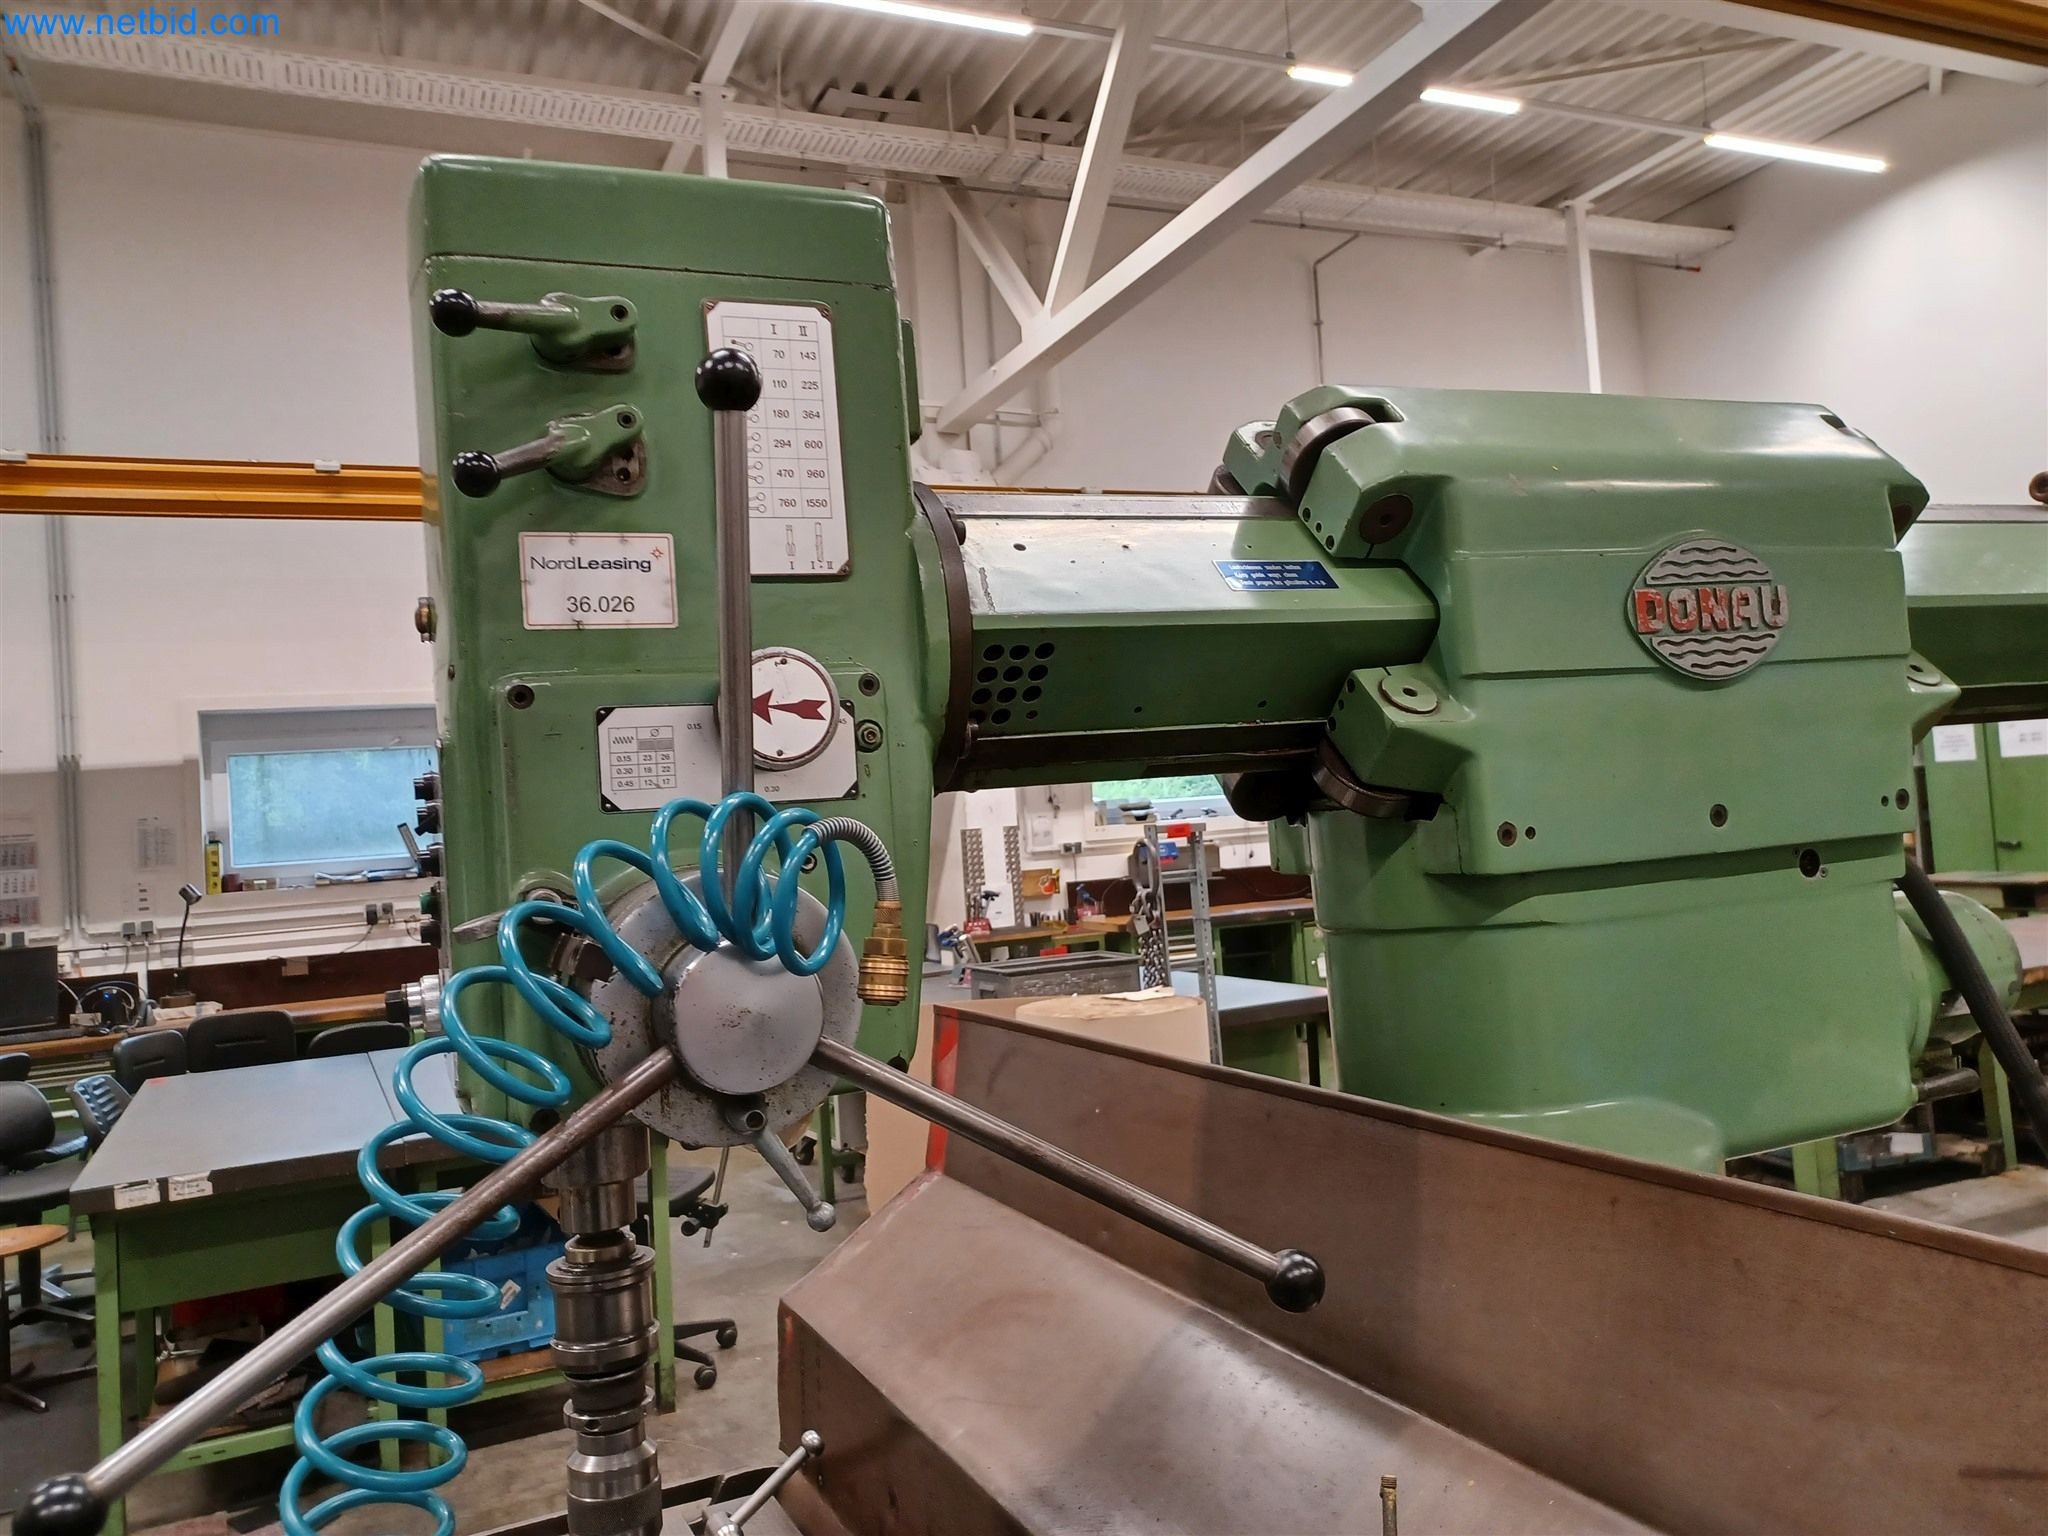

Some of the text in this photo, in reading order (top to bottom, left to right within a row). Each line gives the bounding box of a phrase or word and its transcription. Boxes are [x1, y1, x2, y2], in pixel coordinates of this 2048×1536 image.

[798, 324, 808, 337] II
[772, 349, 817, 361] 70 143
[772, 379, 819, 391] 110 225
[772, 409, 821, 420] 180 364
[773, 438, 823, 450] 294 600
[776, 468, 826, 480] 470 960
[778, 498, 828, 508] 760 1550
[530, 555, 653, 573] NordLeasing
[566, 595, 636, 613] 36.026
[1633, 584, 1789, 634] DONAU
[616, 779, 634, 788] 0.45
